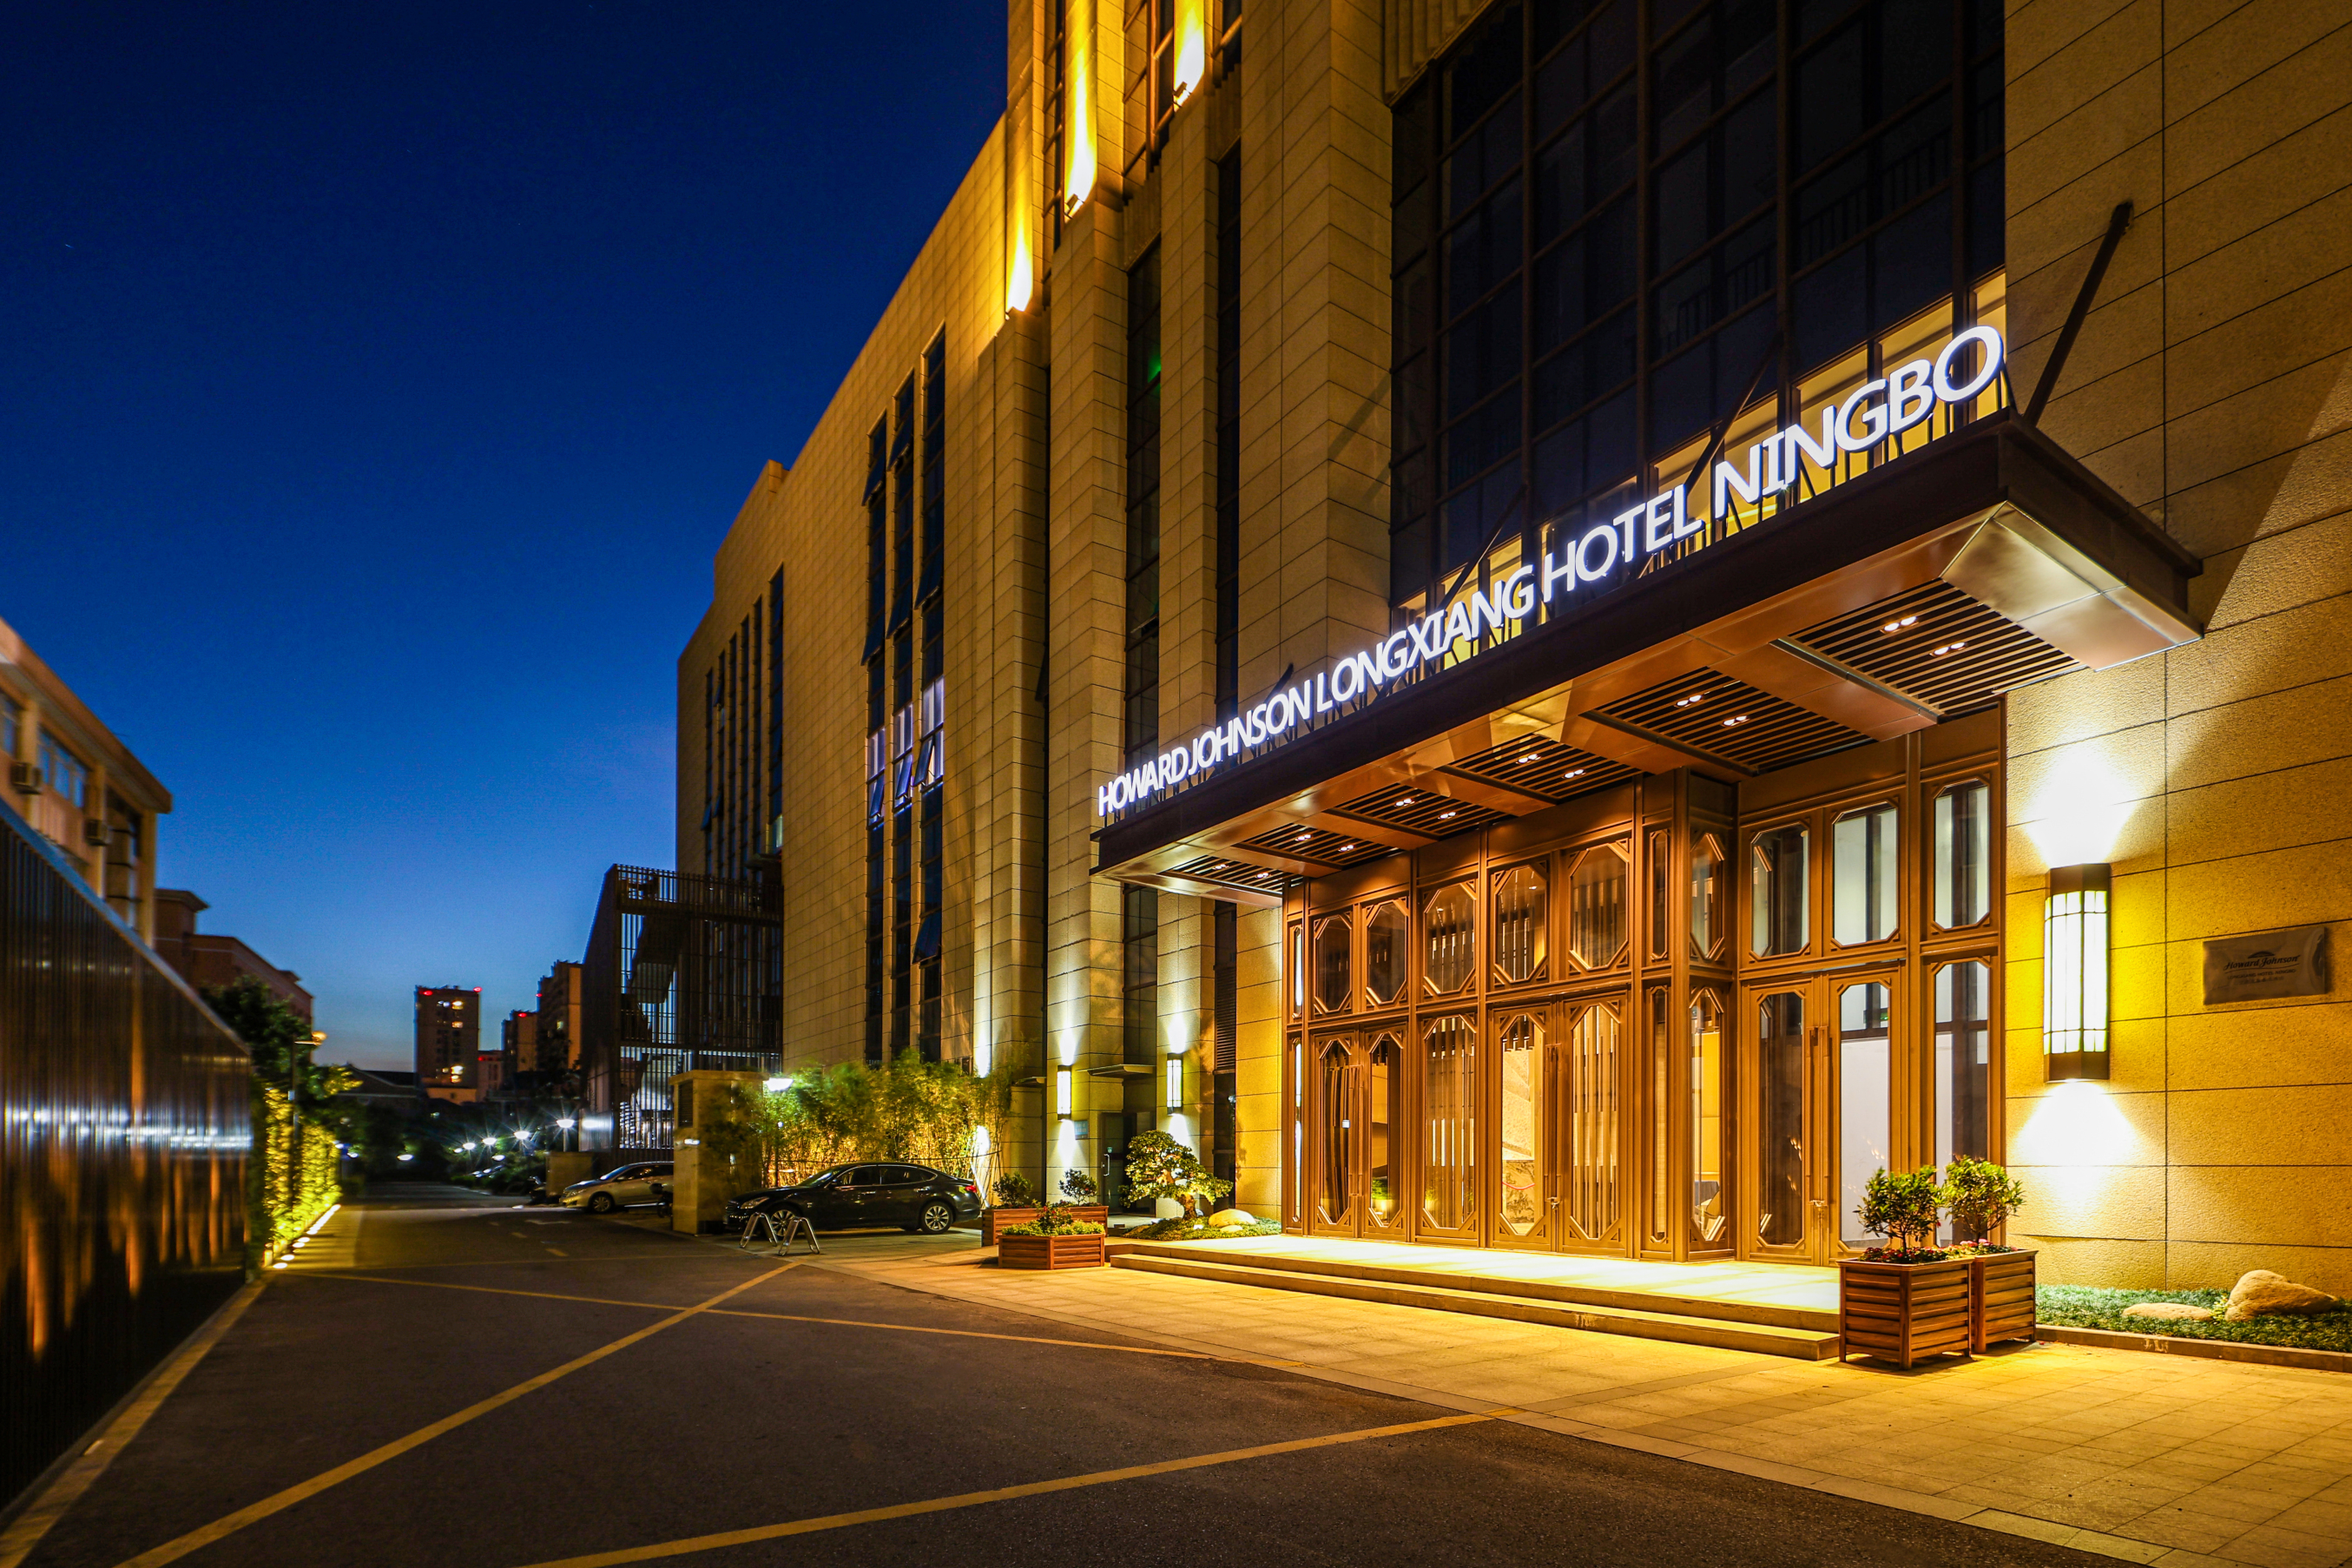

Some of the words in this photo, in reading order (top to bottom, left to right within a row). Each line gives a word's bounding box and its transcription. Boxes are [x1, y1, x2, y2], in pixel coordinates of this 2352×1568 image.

[1097, 746, 1190, 817] HOWARD
[1188, 679, 1313, 775] JOHNSON
[1316, 564, 1535, 713] LONGXIANG
[1542, 484, 1704, 603] HOTEL
[1715, 325, 2003, 520] NINGBO
[2224, 959, 2260, 971] Howard
[2259, 954, 2301, 968] Johnson
